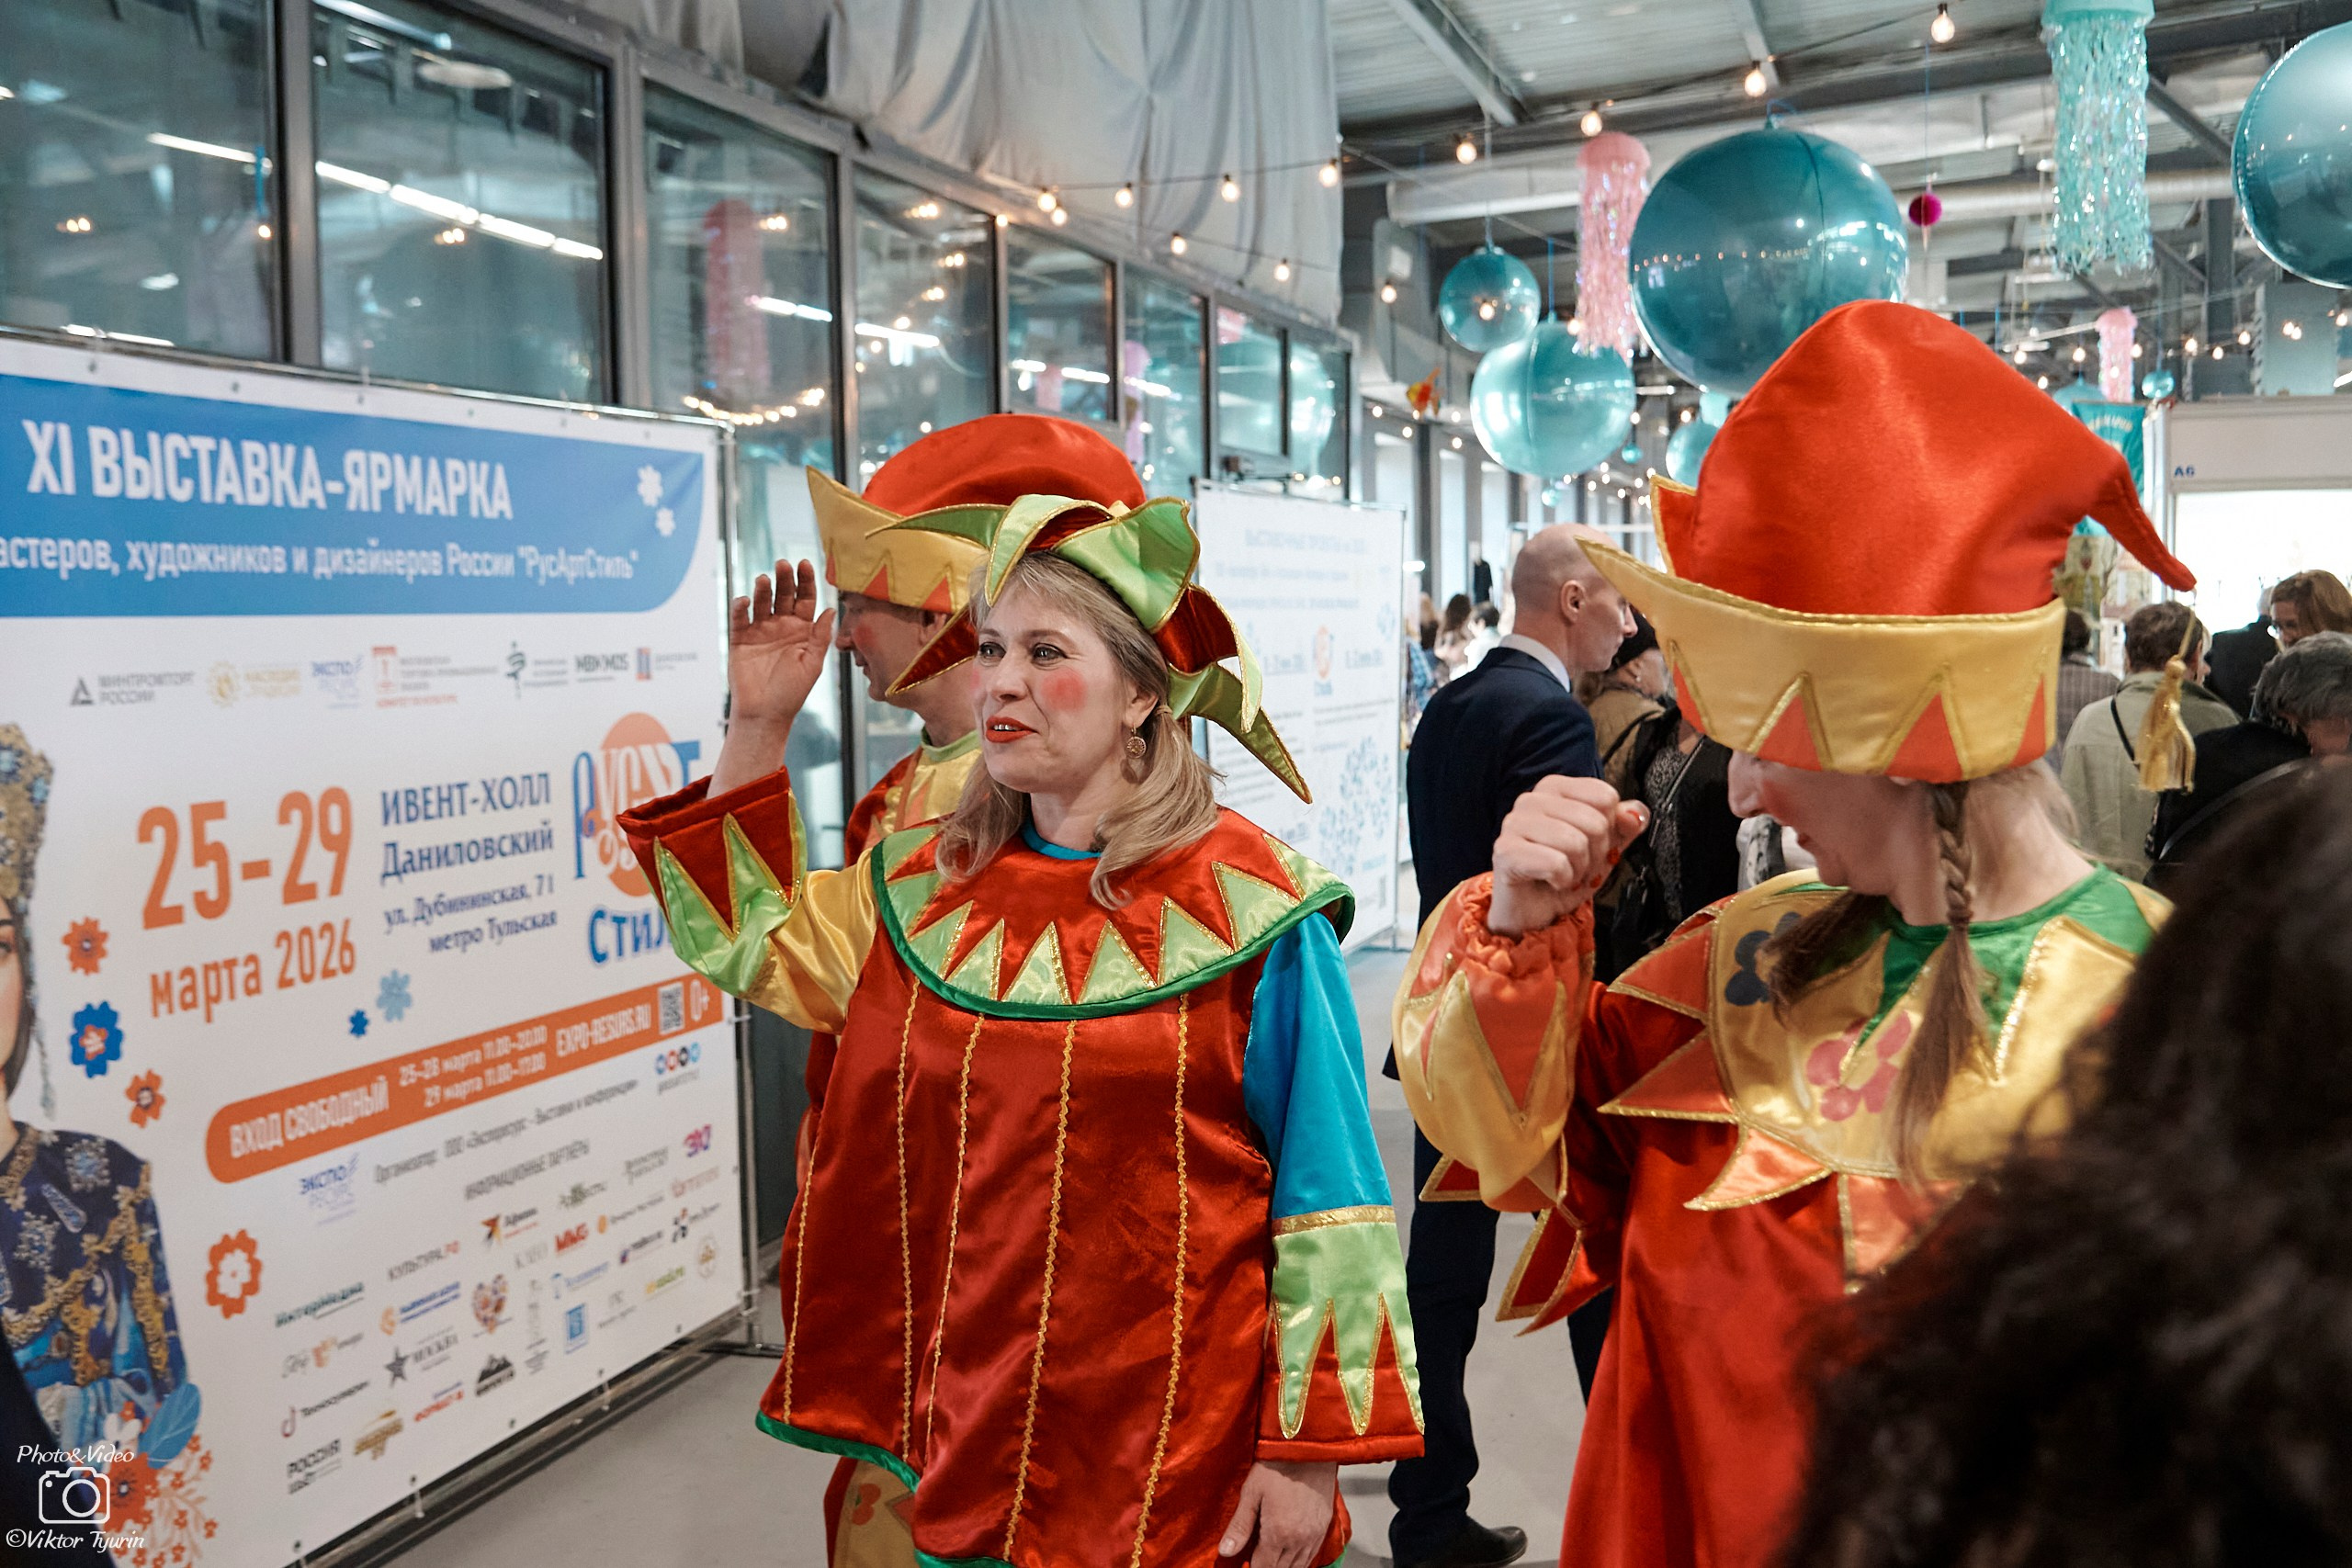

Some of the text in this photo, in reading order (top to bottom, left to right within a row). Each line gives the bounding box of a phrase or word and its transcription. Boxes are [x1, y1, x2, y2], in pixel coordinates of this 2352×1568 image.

[87, 424, 514, 521] ВЫСТАВКА-ЯРМАРКА
[125, 540, 288, 581] художников
[292, 547, 309, 575] и
[313, 537, 443, 585] дизайнеров
[447, 542, 515, 577] России
[381, 773, 550, 827] ИВЕНТ-ХОЛЛ
[379, 818, 554, 887] Даниловский
[383, 908, 410, 935] ул.
[429, 909, 558, 954] метро Тульская
[151, 919, 356, 1025] марта 2026
[556, 1002, 651, 1058] EXPO-RESURS.RU
[441, 1049, 482, 1074] марта
[230, 1074, 390, 1159] ВХОД СВОБОДНЫЙ
[424, 1085, 441, 1108] 29
[442, 1076, 484, 1101] марта
